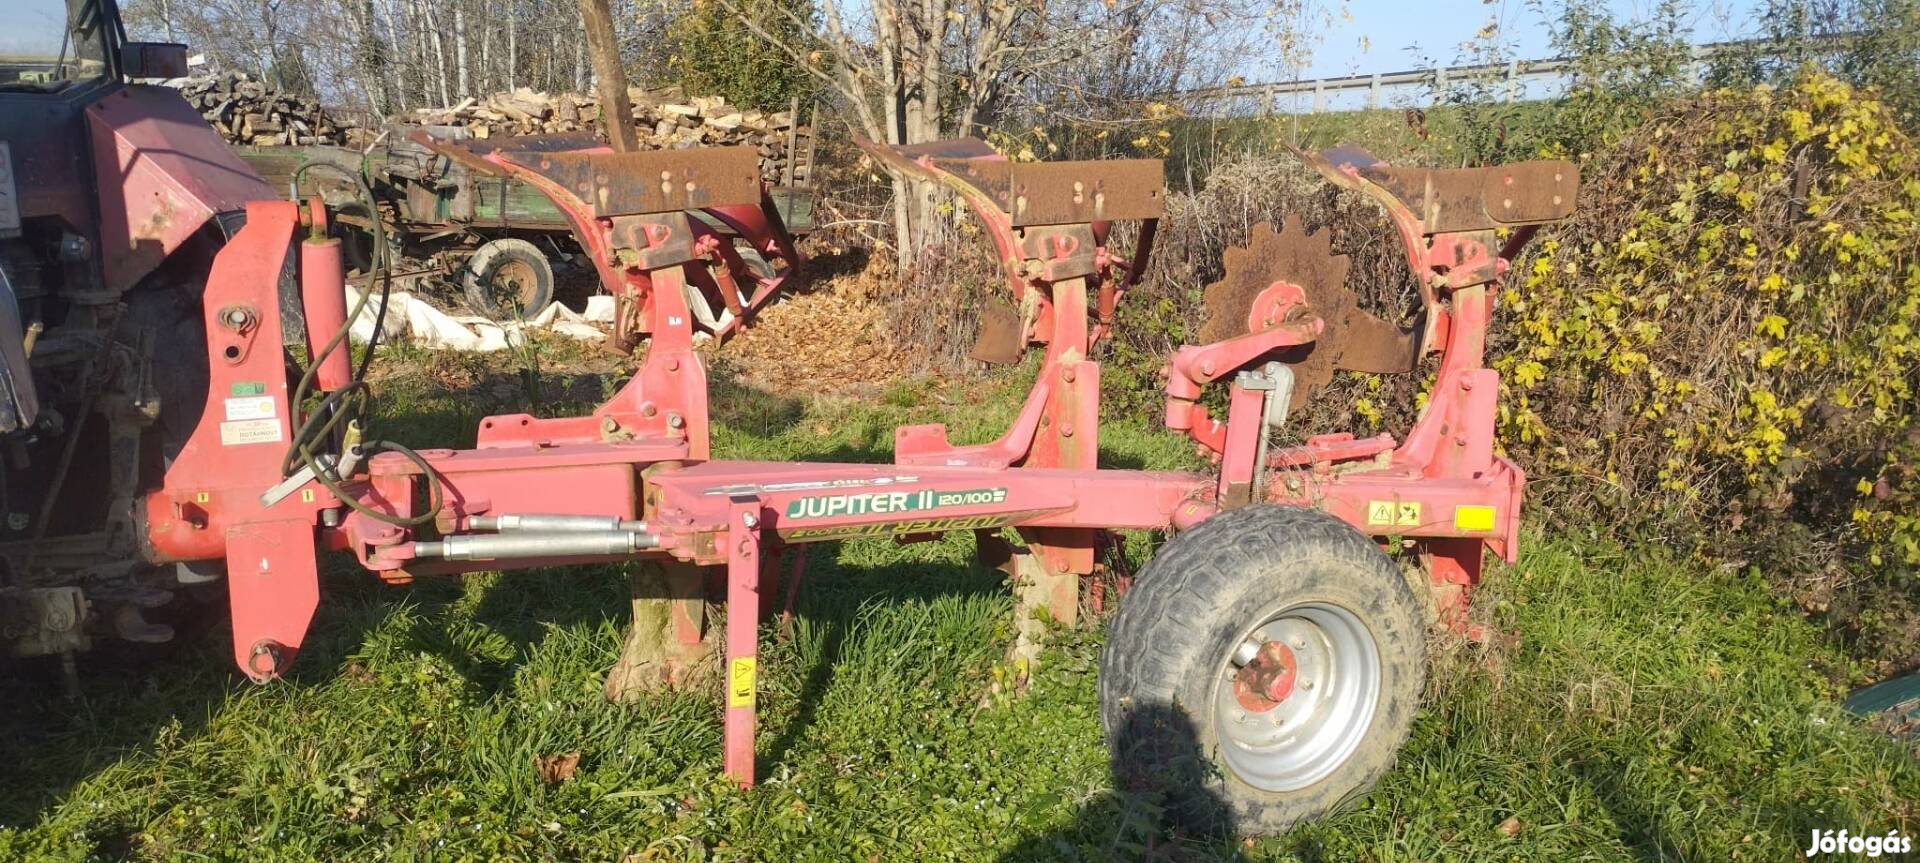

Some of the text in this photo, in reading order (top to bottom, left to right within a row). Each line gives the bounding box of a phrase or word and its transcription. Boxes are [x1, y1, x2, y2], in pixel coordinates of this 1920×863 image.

[790, 490, 993, 518] JUPITER II 120/100
